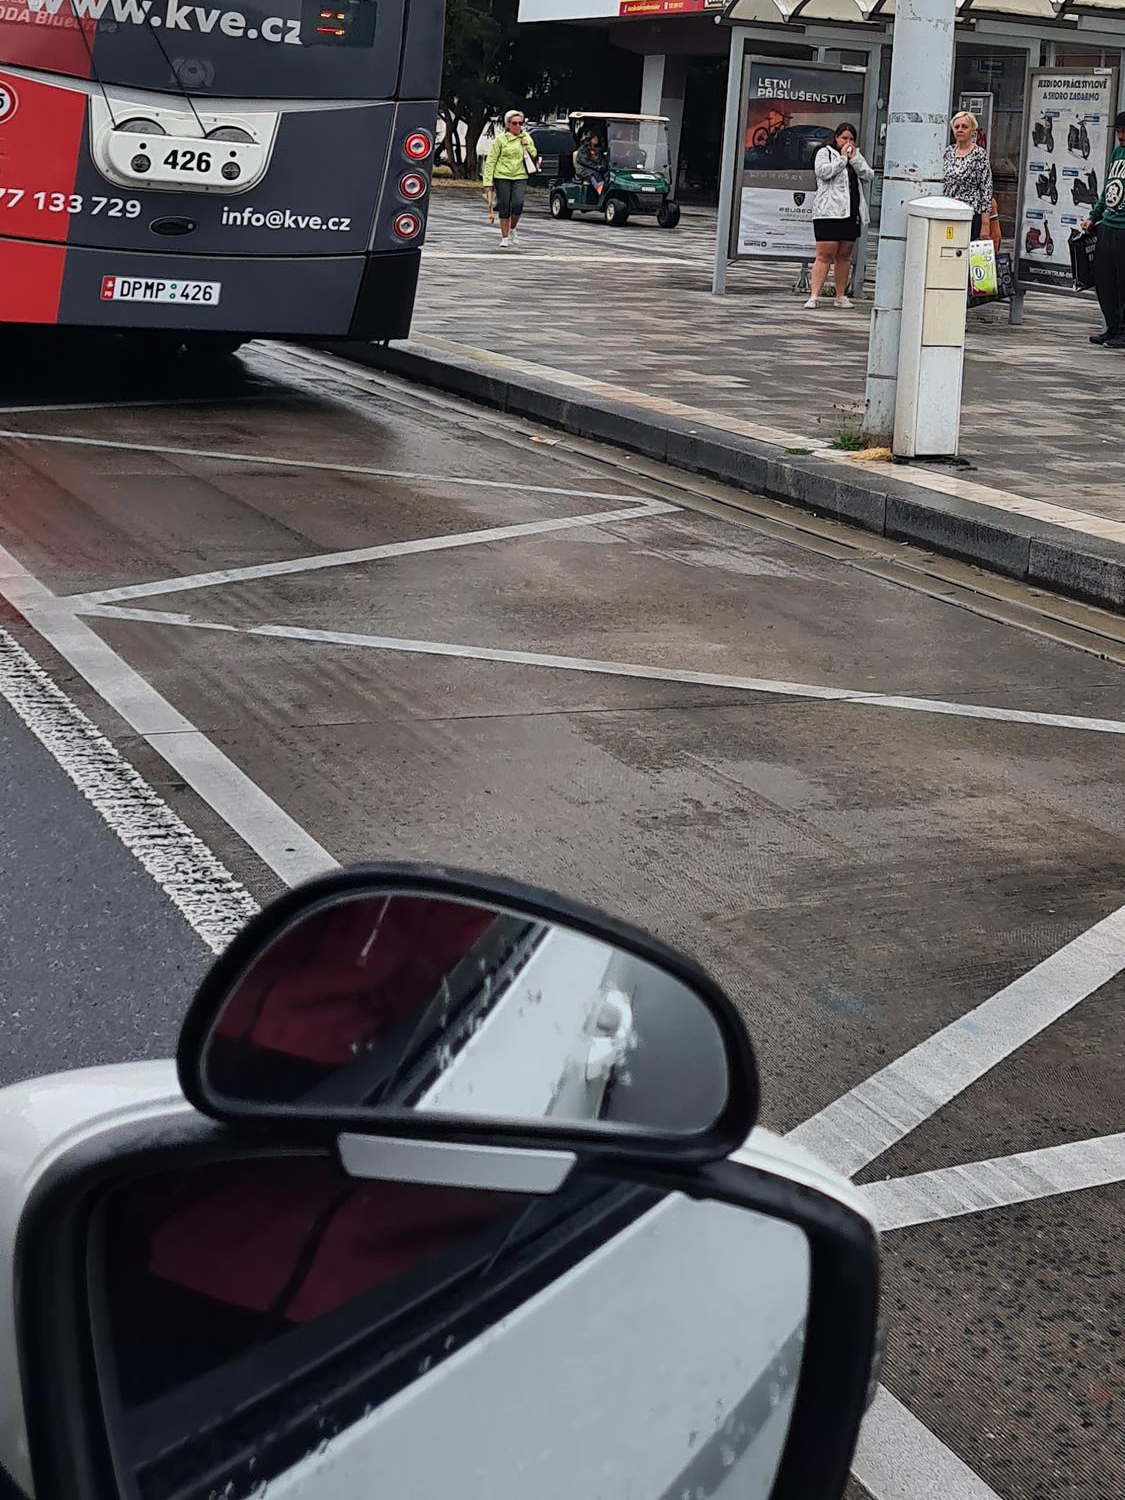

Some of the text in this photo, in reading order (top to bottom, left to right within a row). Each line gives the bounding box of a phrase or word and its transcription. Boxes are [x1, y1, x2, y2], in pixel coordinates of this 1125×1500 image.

[758, 77, 792, 89] LETNÍ
[1053, 80, 1063, 88] DO
[757, 88, 846, 105] PŘÍSLUŠENSTVÍ
[1043, 92, 1048, 100] A
[1069, 92, 1100, 101] ZADARMO
[163, 148, 212, 174] 426
[32, 190, 84, 215] 133
[91, 196, 142, 219] 729
[779, 206, 813, 214] PEUGEO
[221, 206, 352, 232] info@kve.cz
[120, 280, 166, 300] DPMP
[180, 283, 214, 302] 426
